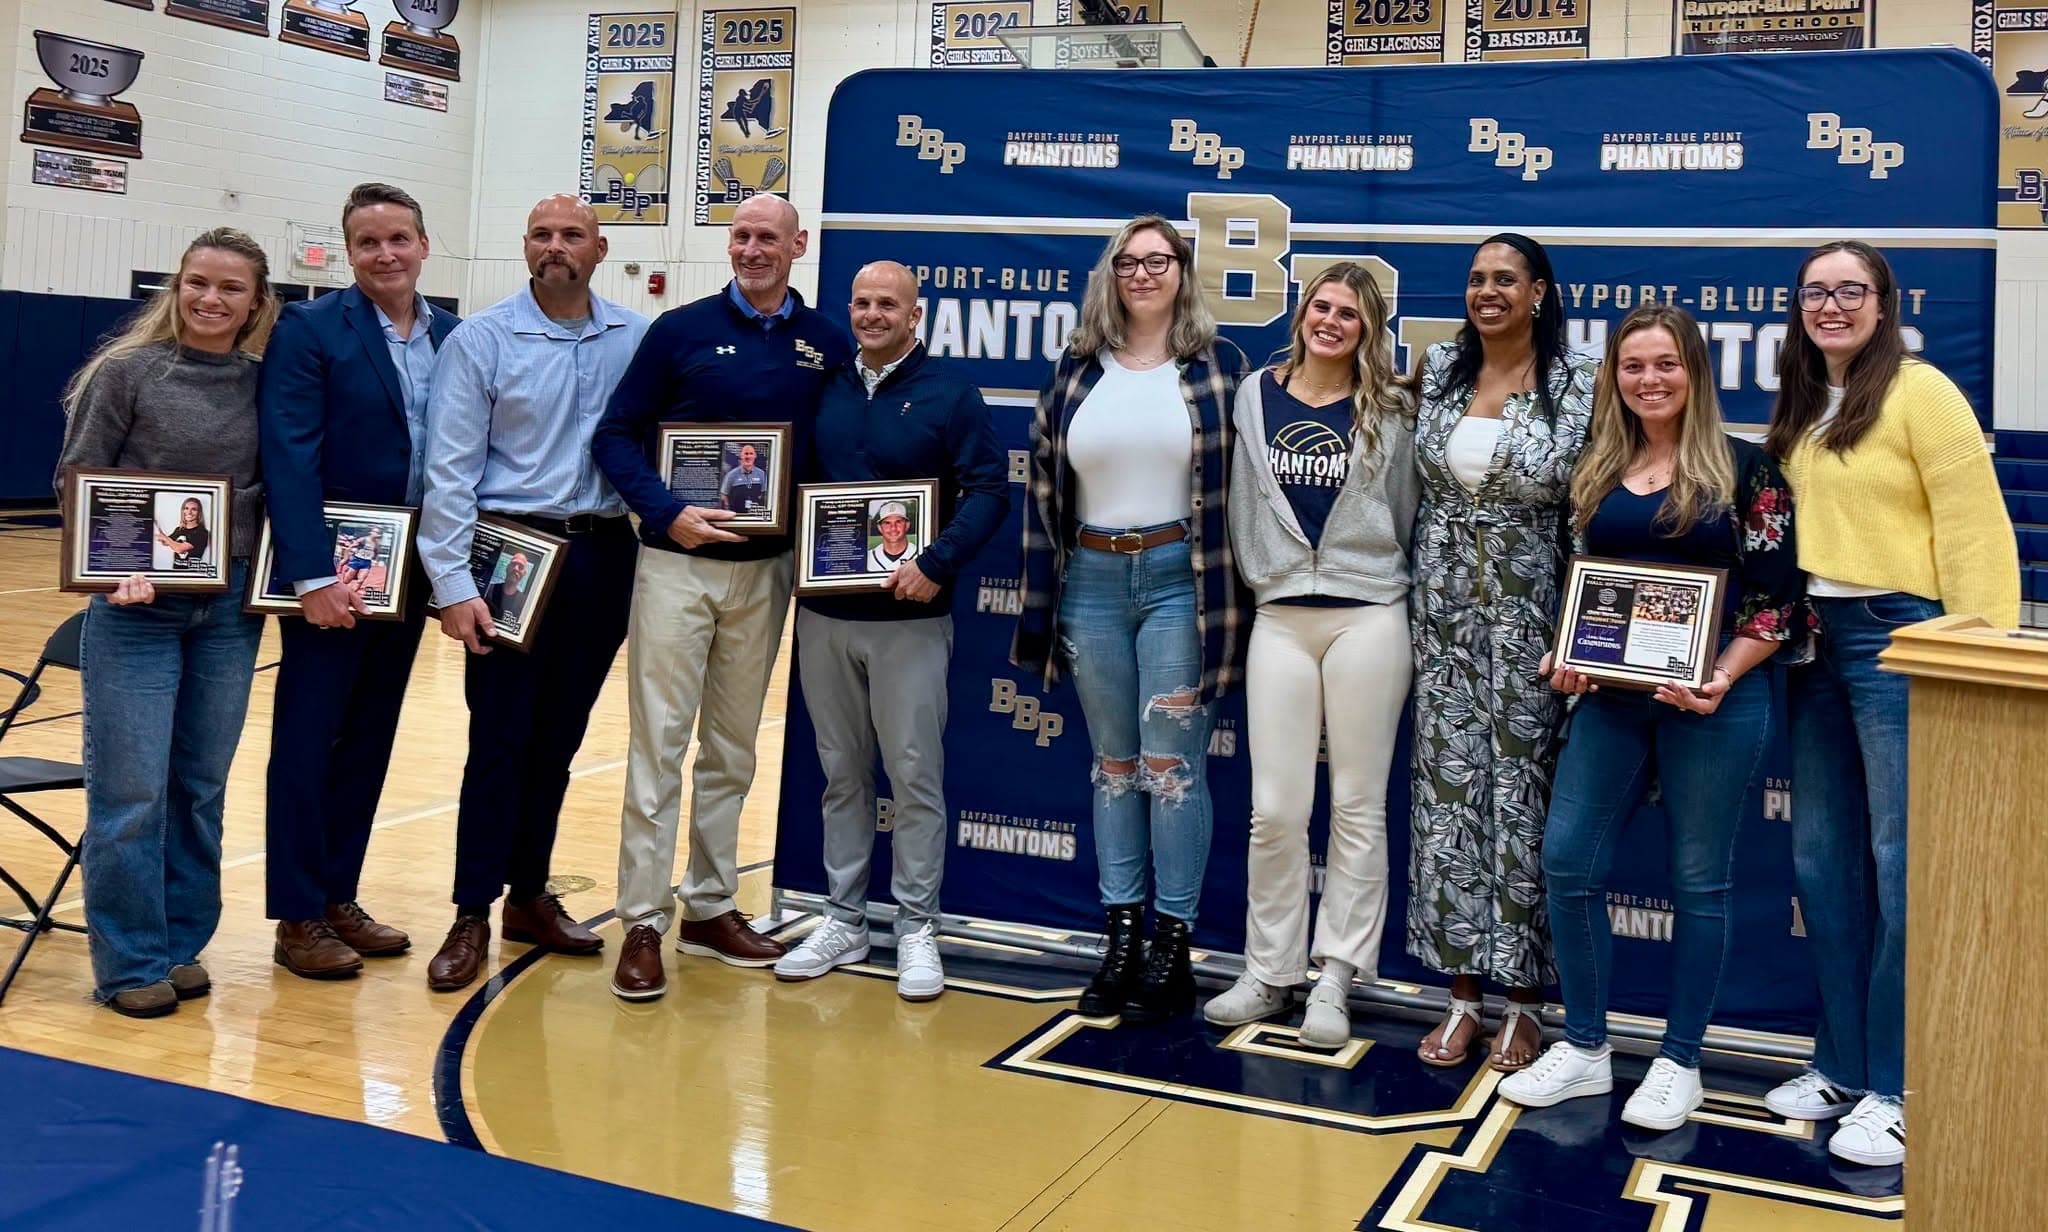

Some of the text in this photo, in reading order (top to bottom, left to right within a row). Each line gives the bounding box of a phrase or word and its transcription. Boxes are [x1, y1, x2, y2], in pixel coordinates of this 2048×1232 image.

[1328, 0, 1343, 26] EW
[1353, 0, 1431, 26] 2023
[1492, 0, 1577, 20] 2014
[1685, 0, 1806, 16] BAYPORT-BLUE
[1998, 12, 2031, 28] GIRLS
[606, 22, 667, 48] 2025
[702, 12, 715, 45] NEW
[722, 18, 785, 44] 2025
[932, 5, 946, 39] NEW
[953, 12, 1019, 39] 2024
[1763, 16, 1854, 29] SCHOOL
[1974, 2, 1993, 51] YORK
[1071, 45, 1100, 59] BOYS
[1345, 36, 1440, 52] GIRLS LACROSSE
[1466, 24, 1482, 62] YOR
[1487, 30, 1582, 48] BASEBALL
[69, 53, 110, 78] 2025
[600, 56, 673, 71] GIRLS TENNIS
[715, 54, 792, 68] GIRLS LACROSSE
[896, 114, 966, 174] BBP
[1007, 131, 1120, 143] BAYPORT-BLUE POINT
[1168, 119, 1245, 179] BBP
[1290, 134, 1413, 145] BAYPORT-BLUE POINT
[1467, 118, 1553, 181] BBP
[1603, 131, 1743, 143] BAYPORT-BLUE POINT
[1806, 112, 1905, 180] BBP
[1003, 141, 1120, 168] PHANTOMS
[1287, 144, 1414, 171] PHANTOMS
[1600, 143, 1744, 171] PHANTOMS
[905, 264, 1070, 292] PORT-BLUE
[989, 678, 1064, 747] BBP
[957, 819, 1077, 861] PHANTOMS
